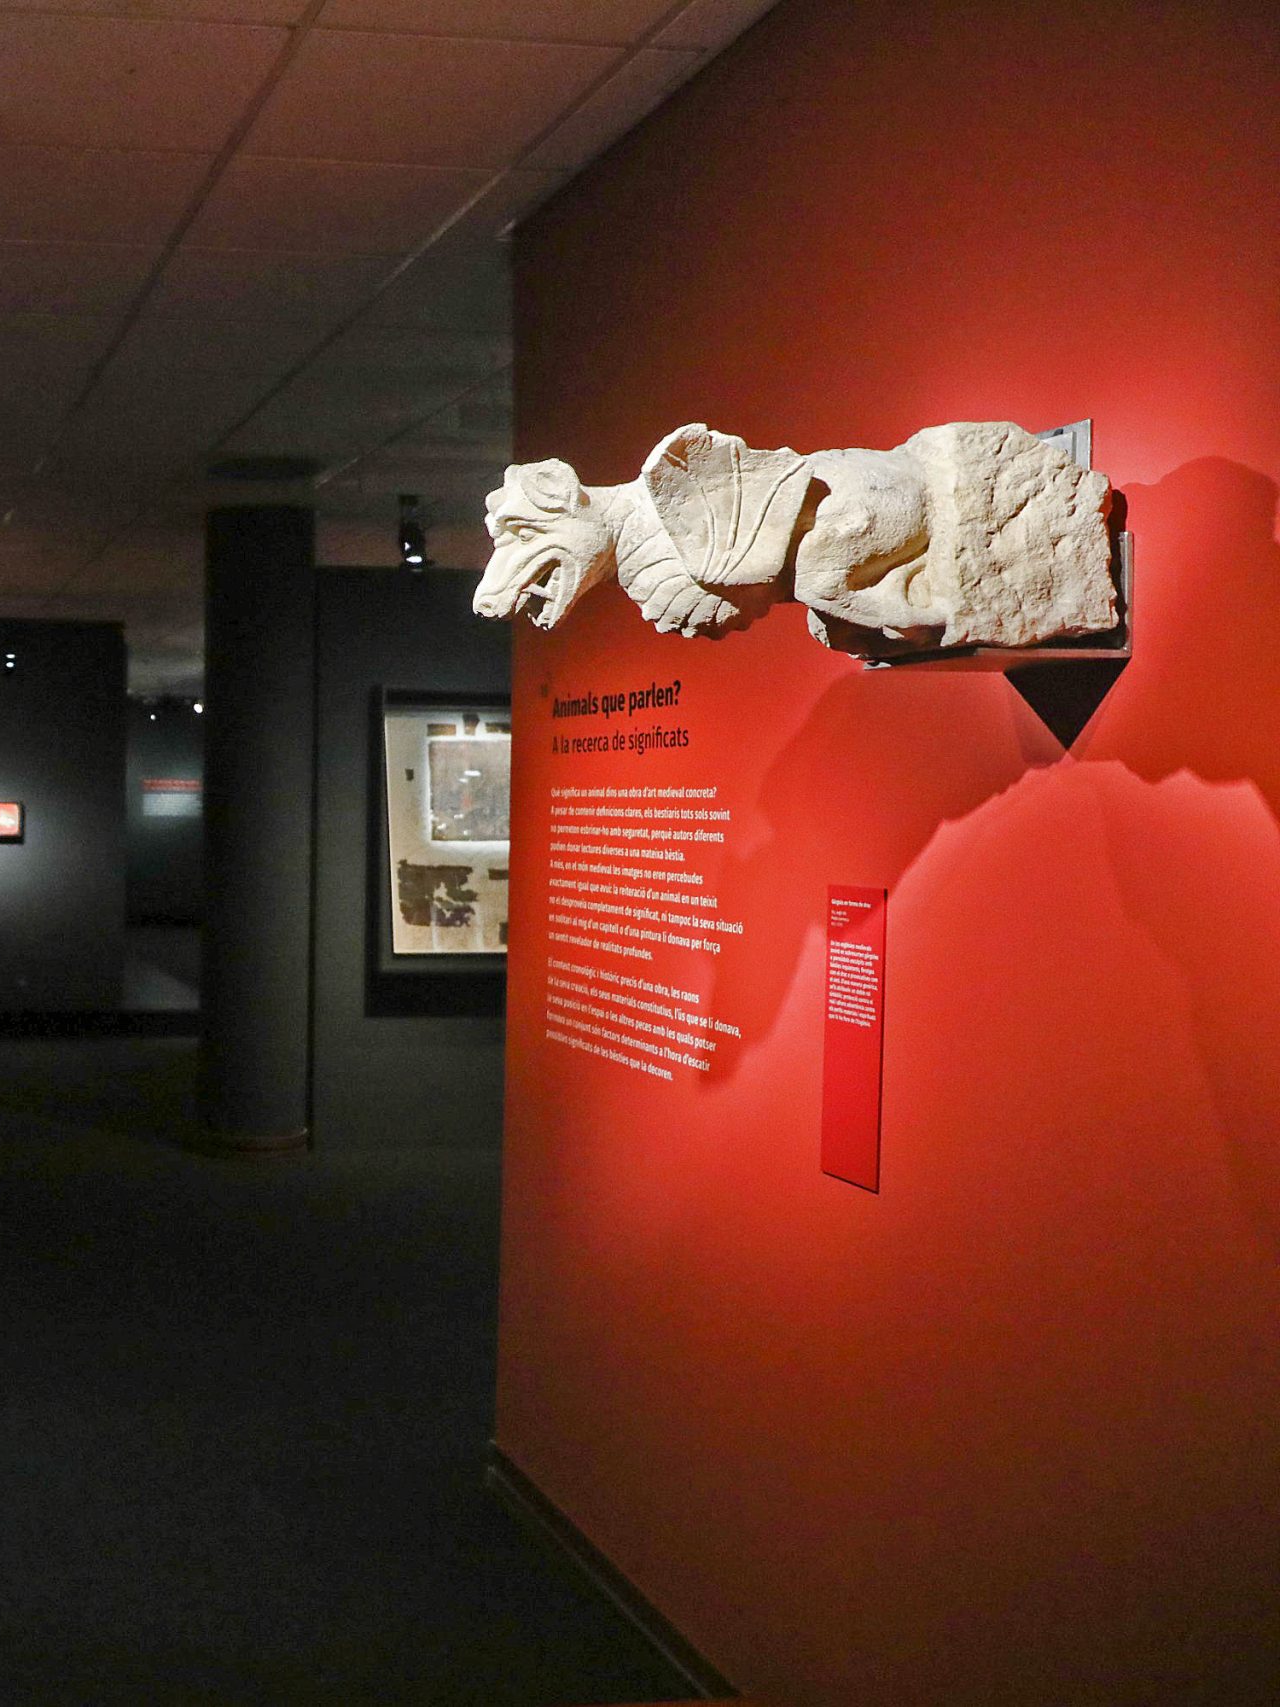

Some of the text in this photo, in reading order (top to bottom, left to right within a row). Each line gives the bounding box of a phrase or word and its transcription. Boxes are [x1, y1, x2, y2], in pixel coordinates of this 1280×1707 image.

[552, 680, 681, 718] Animals que parlen?
[552, 726, 688, 756] A la recerca de significats
[606, 787, 616, 797] dins
[618, 789, 628, 797] una
[628, 787, 641, 798] obra
[642, 787, 656, 797] d'art
[657, 787, 684, 797] medieval
[685, 787, 717, 798] concreta?
[624, 808, 643, 818] clares,
[644, 808, 652, 818] els
[654, 808, 679, 818] bestiaris
[680, 809, 693, 819] tots
[694, 809, 708, 820] sols
[709, 809, 730, 820] sovint
[610, 827, 620, 836] amb
[622, 829, 650, 839] seguretat,
[650, 828, 671, 840] perquè
[672, 831, 692, 840] autors
[694, 830, 724, 842] diferents
[602, 845, 624, 856] diverses
[629, 849, 640, 857] una
[640, 849, 663, 859] mateixa
[664, 849, 685, 861] bèstia.
[622, 868, 642, 879] imatges
[652, 871, 665, 880] eren
[666, 872, 703, 884] percebudes
[619, 887, 645, 898] reiteració
[646, 888, 659, 900] d'un
[660, 891, 680, 903] animal
[632, 908, 660, 922] significat,
[668, 914, 690, 926] tampoc
[699, 919, 714, 929] seva
[716, 920, 743, 934] situació
[624, 925, 639, 937] d'una
[640, 930, 661, 941] pintura
[668, 933, 690, 947] donava
[691, 939, 702, 950] per
[702, 939, 720, 954] força
[623, 947, 652, 960] profundes.
[638, 979, 653, 992] d'una
[654, 984, 670, 997] obra,
[670, 987, 680, 999] les
[680, 992, 699, 1003] raons
[611, 994, 636, 1008] materials
[637, 1002, 673, 1019] constitutius,
[674, 1008, 685, 1021] l'ús
[686, 1014, 698, 1025] que
[714, 1020, 741, 1038] donava,
[618, 1014, 634, 1027] altres
[635, 1020, 651, 1032] peces
[652, 1025, 665, 1036] amb
[666, 1027, 675, 1039] les
[676, 1033, 693, 1045] quals
[694, 1038, 716, 1050] potser
[601, 1028, 620, 1042] factors
[620, 1036, 658, 1054] determinants
[664, 1047, 680, 1062] l'hora
[682, 1054, 710, 1070] d'escatir
[600, 1047, 608, 1058] les
[610, 1050, 628, 1065] bèsties
[630, 1058, 640, 1069] que
[648, 1064, 673, 1080] decoren.
